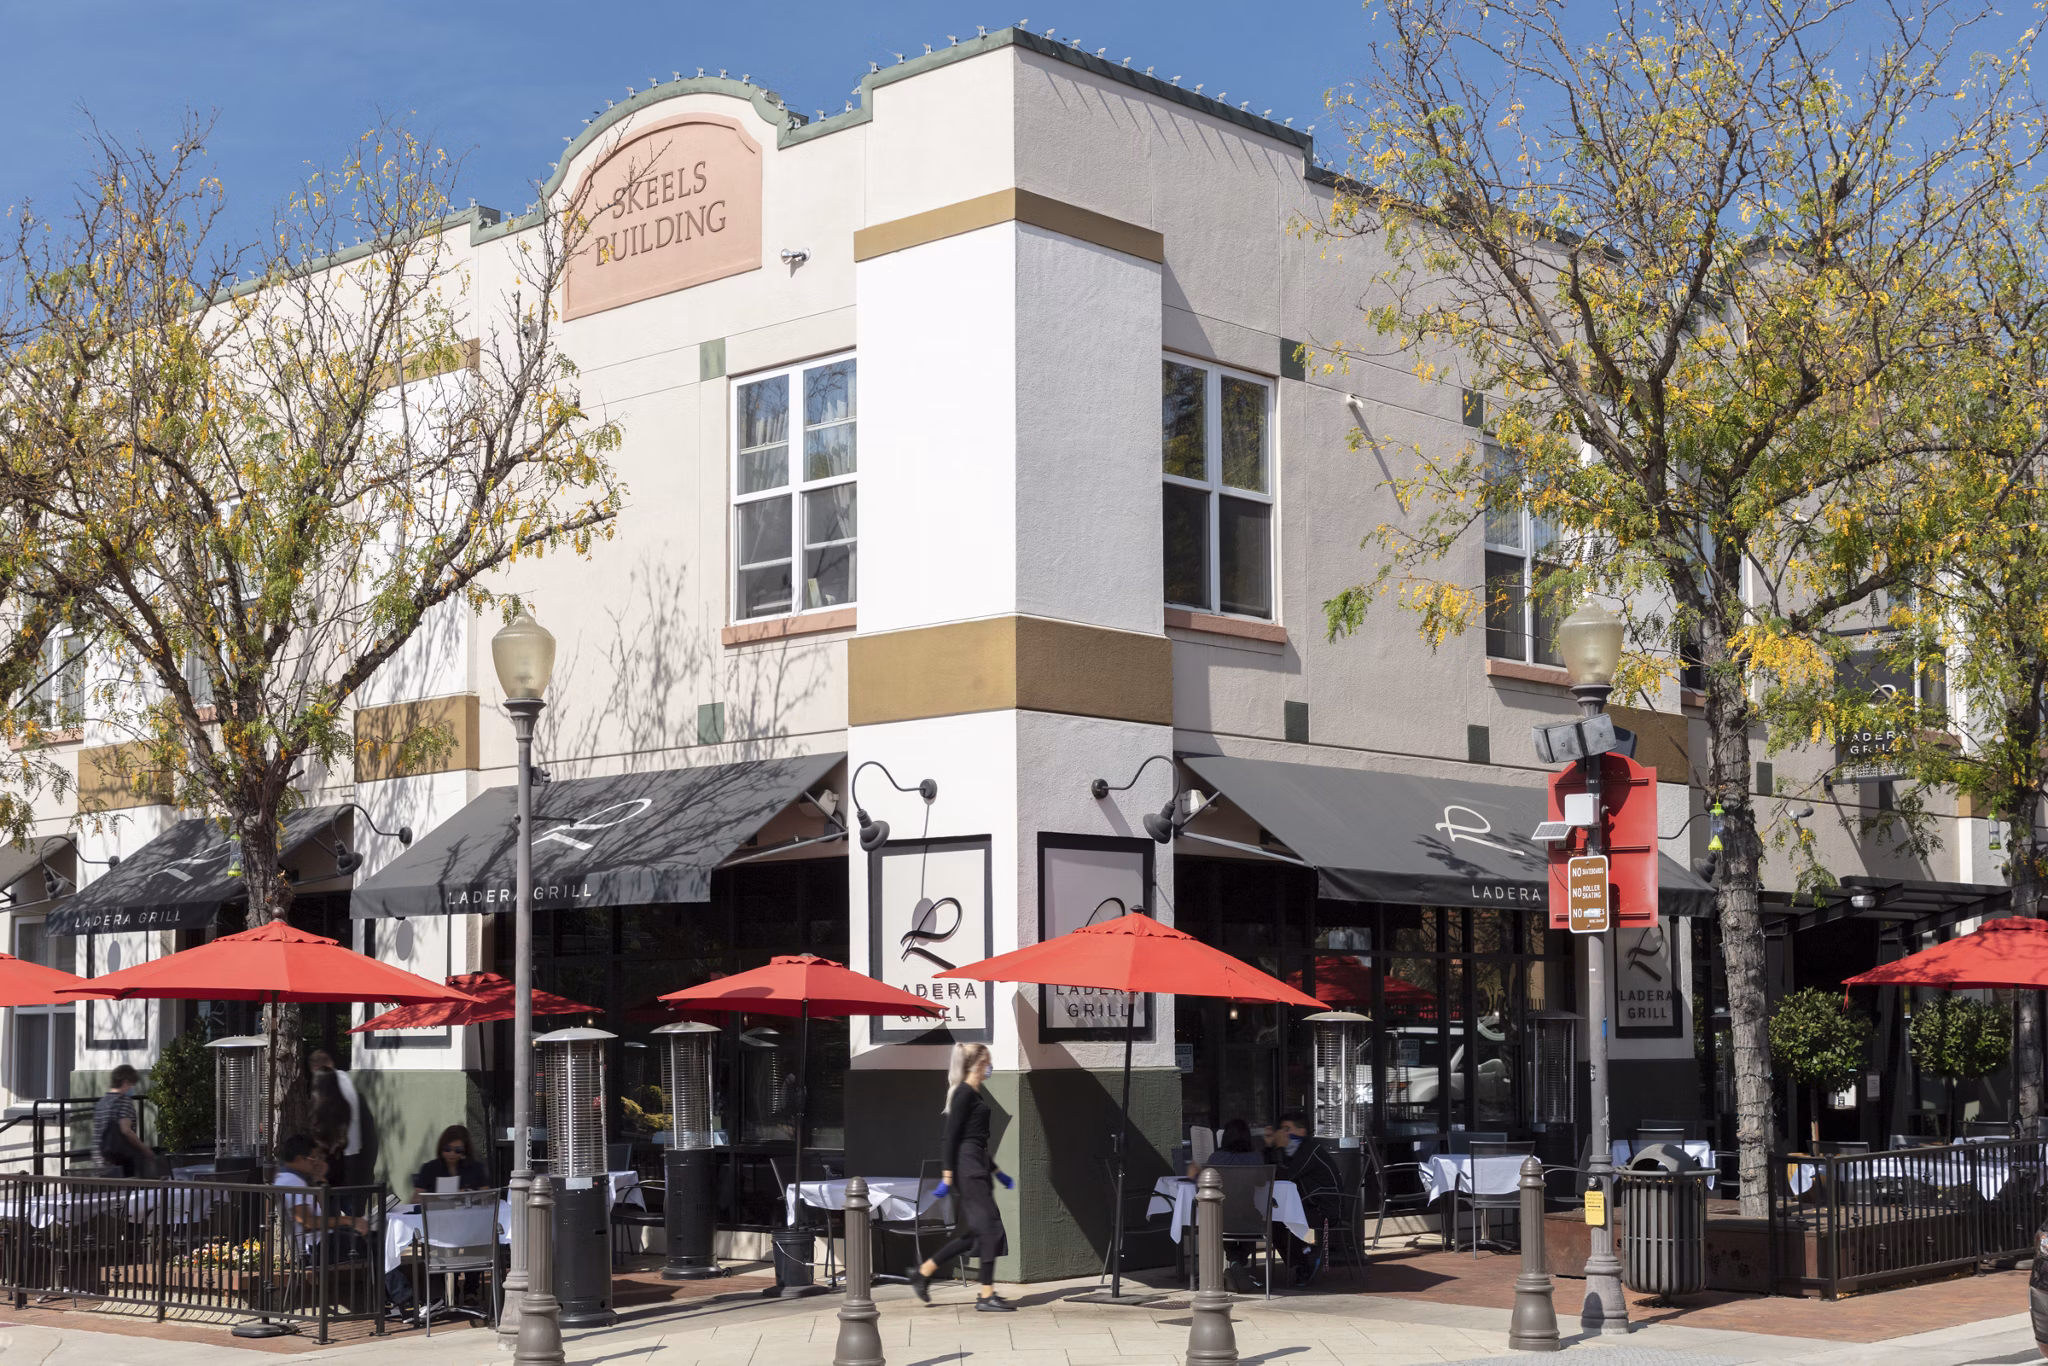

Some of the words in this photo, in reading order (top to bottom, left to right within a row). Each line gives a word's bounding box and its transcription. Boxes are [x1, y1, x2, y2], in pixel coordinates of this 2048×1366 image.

[612, 160, 707, 219] SKEELS
[595, 200, 726, 267] BUILDING
[1572, 867, 1582, 877] NO
[533, 883, 592, 900] GRILL
[1471, 885, 1541, 901] LADERA
[1572, 888, 1582, 898] NO
[1582, 891, 1601, 899] SKATING
[75, 914, 131, 928] LADERA
[138, 910, 181, 924] GRILL
[1572, 908, 1582, 918] NO
[902, 982, 977, 999] ADERA
[1619, 990, 1672, 1001] LADERA
[1068, 1003, 1128, 1018] GRILL
[1628, 1007, 1667, 1019] GRILL
